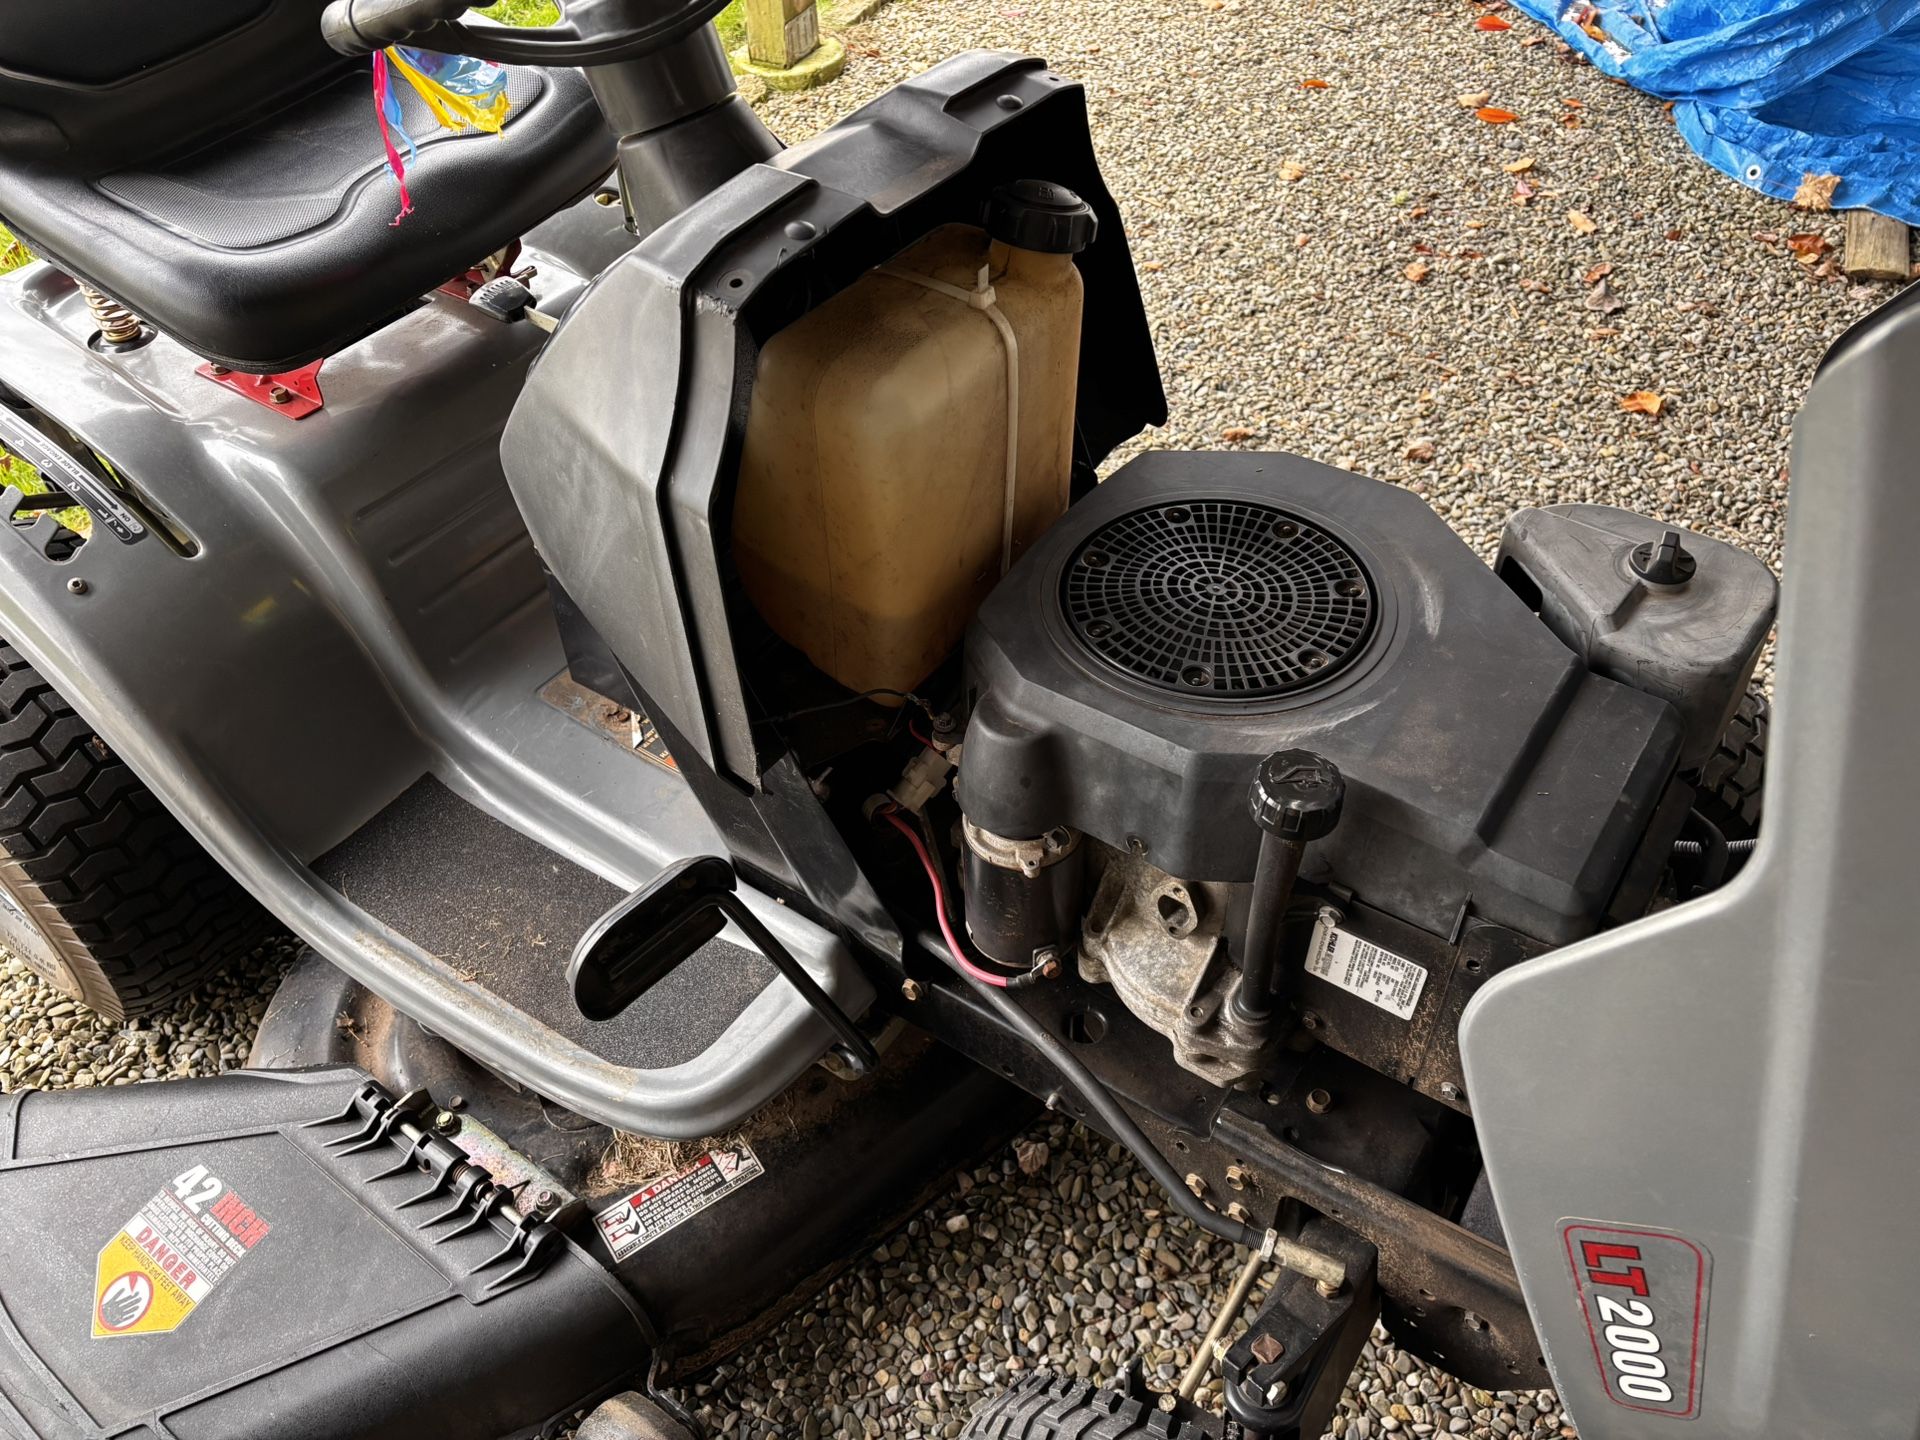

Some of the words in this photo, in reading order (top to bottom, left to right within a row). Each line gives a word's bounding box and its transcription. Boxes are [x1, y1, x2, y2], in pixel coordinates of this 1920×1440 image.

[60, 458, 80, 475] BLADE
[67, 482, 80, 492] 2
[119, 511, 130, 523] ON
[172, 1164, 222, 1214] 42
[209, 1189, 271, 1249] INCH
[635, 1199, 651, 1212] KEEP
[650, 1188, 670, 1203] HANDS
[670, 1180, 683, 1191] AND
[682, 1172, 697, 1184] FEET
[638, 1208, 648, 1217] DO
[648, 1199, 663, 1211] NOT
[662, 1182, 691, 1202] OPERATE
[691, 1167, 716, 1184] MOWER
[640, 1204, 665, 1221] UNLESS
[664, 1192, 686, 1207] CHUTE
[684, 1172, 718, 1194] DEFLECTOR
[643, 1218, 653, 1226] OR
[652, 1206, 673, 1221] ENTIRE
[672, 1195, 691, 1208] GRASS
[690, 1180, 716, 1197] CATCHER
[714, 1175, 722, 1183] IS
[657, 1212, 685, 1231] DEFLECTOR
[691, 1201, 703, 1210] THIS
[663, 1204, 687, 1221] PROPER
[199, 1211, 231, 1242] CUTTING
[224, 1236, 247, 1258] DECK
[118, 1234, 136, 1253] KEEP
[130, 1247, 153, 1270] HANDS
[147, 1264, 163, 1280] and
[156, 1274, 175, 1293] FEET
[169, 1287, 191, 1310] AWAY
[134, 1225, 199, 1290] DANGER
[205, 1248, 222, 1265] COVER
[216, 1248, 227, 1258] DO
[223, 1254, 236, 1267] NOT
